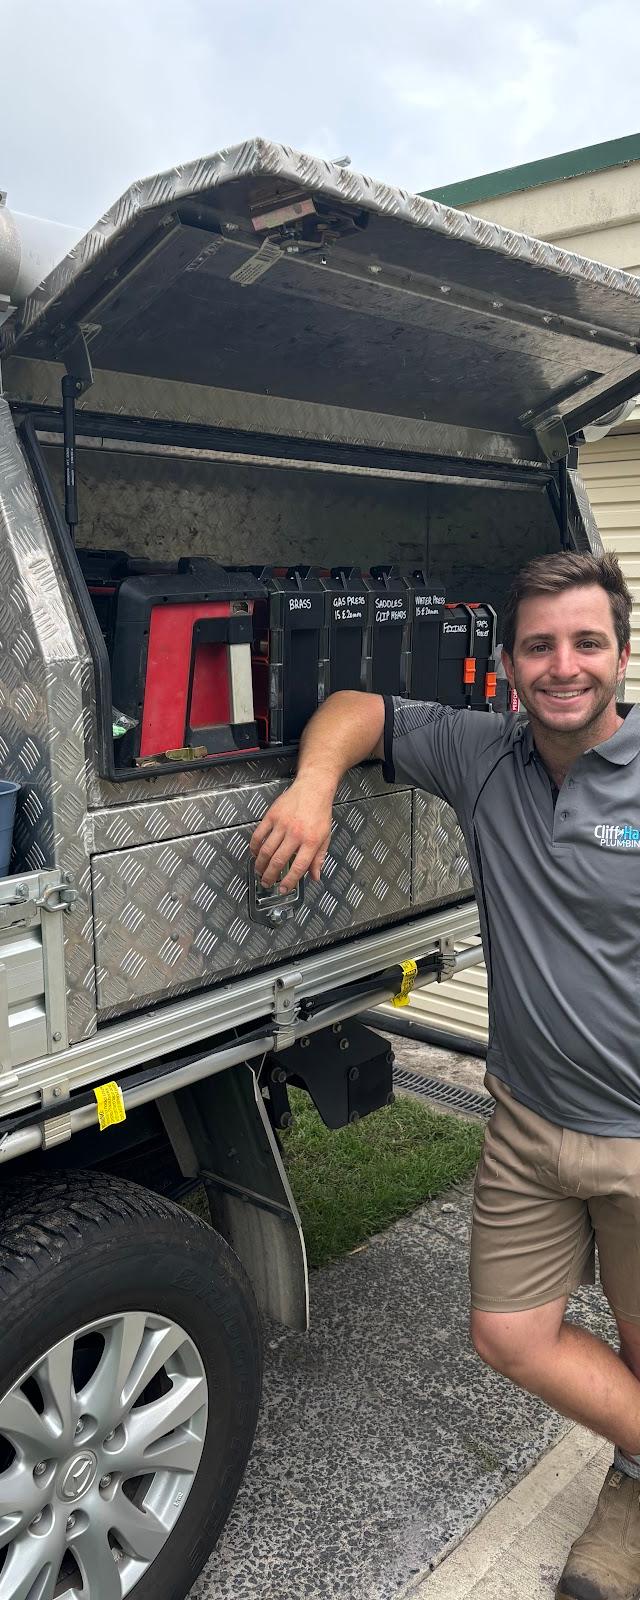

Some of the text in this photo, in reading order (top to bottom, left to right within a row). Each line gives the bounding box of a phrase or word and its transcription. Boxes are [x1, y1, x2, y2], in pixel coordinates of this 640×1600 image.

[289, 598, 312, 611] BRASS
[333, 596, 366, 607] GAS PRESS
[374, 598, 403, 609] SADDLES
[415, 595, 446, 605] WATER PRESS
[375, 610, 407, 623] CLIP HEADS
[443, 622, 467, 633] FIXINGS
[476, 620, 488, 628] TAPS
[594, 824, 640, 840] Cliff Ha
